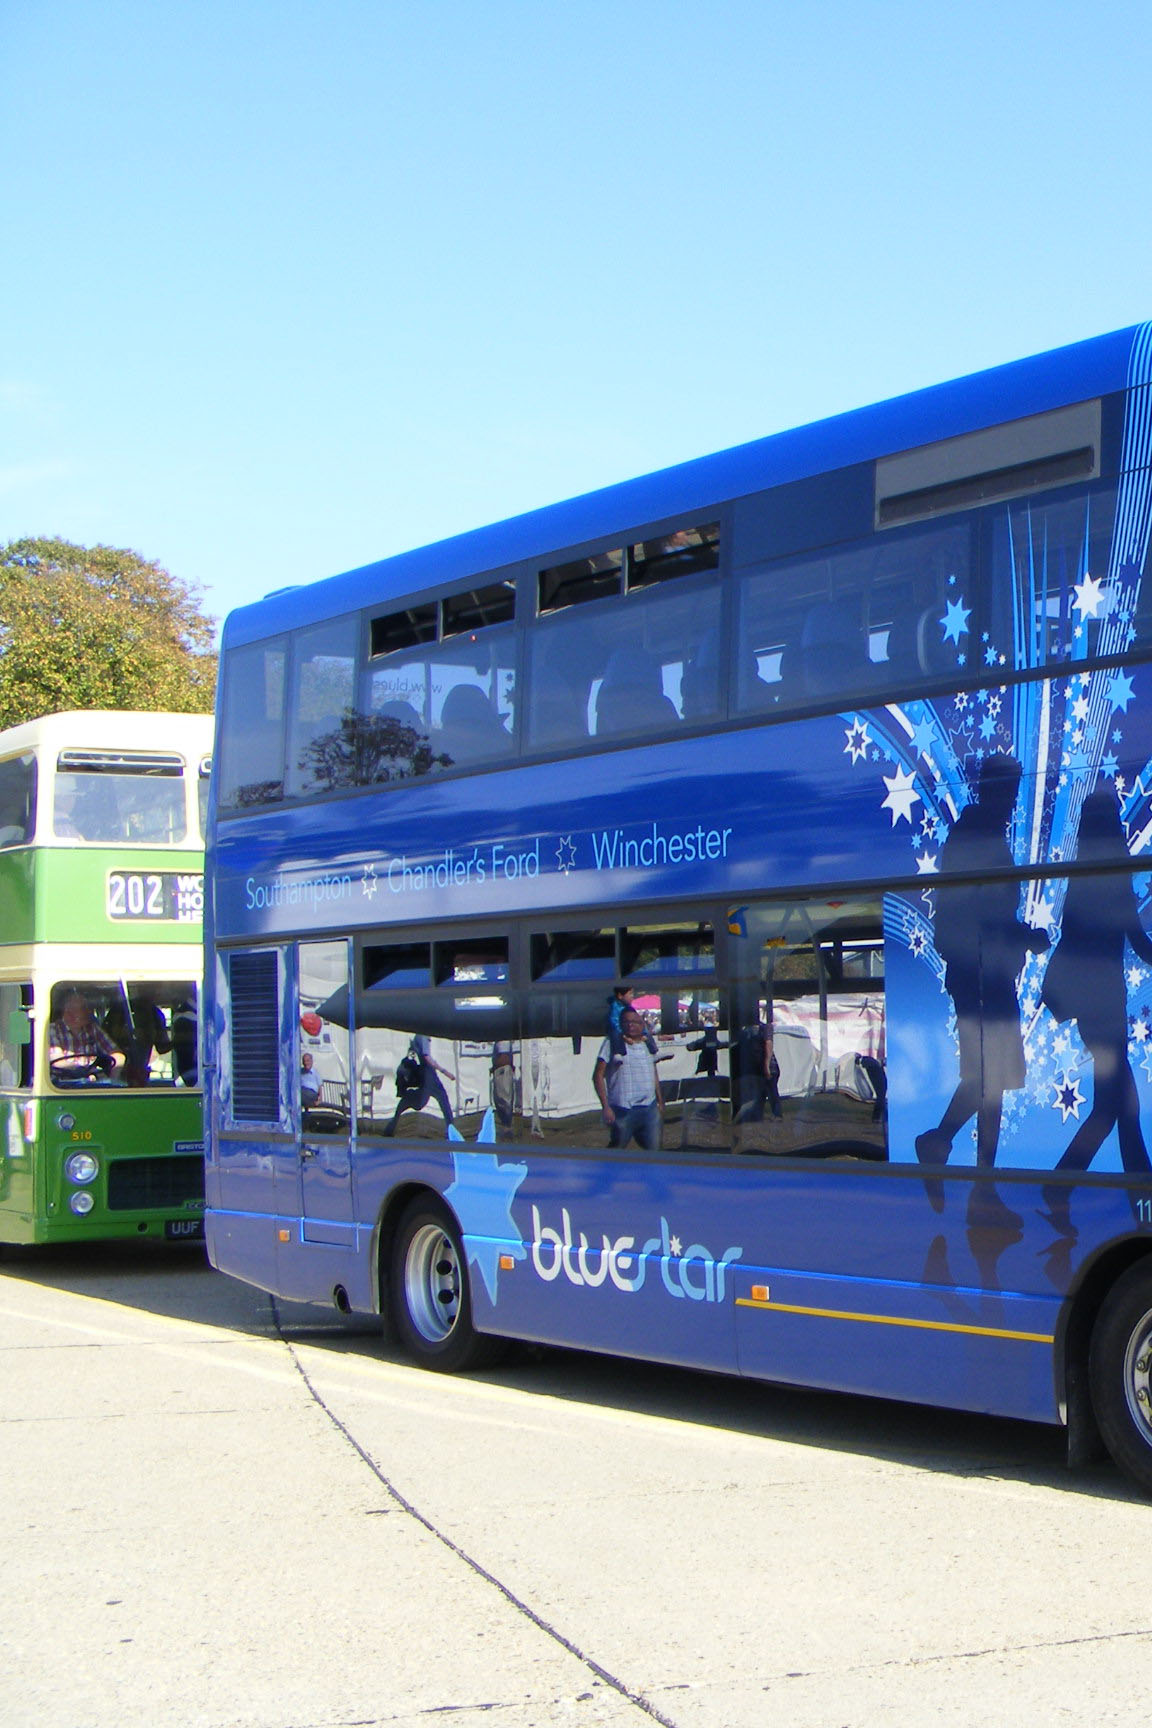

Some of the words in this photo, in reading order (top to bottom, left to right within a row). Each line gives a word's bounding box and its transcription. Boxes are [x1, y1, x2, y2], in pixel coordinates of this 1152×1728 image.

[246, 870, 352, 912] Southampton
[388, 848, 486, 893] Chandler's
[492, 837, 540, 881] Ford
[592, 822, 733, 871] Winchester
[109, 875, 163, 914] 202
[177, 892, 203, 910] HO
[71, 1131, 92, 1141] 510
[172, 1221, 199, 1234] UUF
[532, 1204, 743, 1303] bluestar
